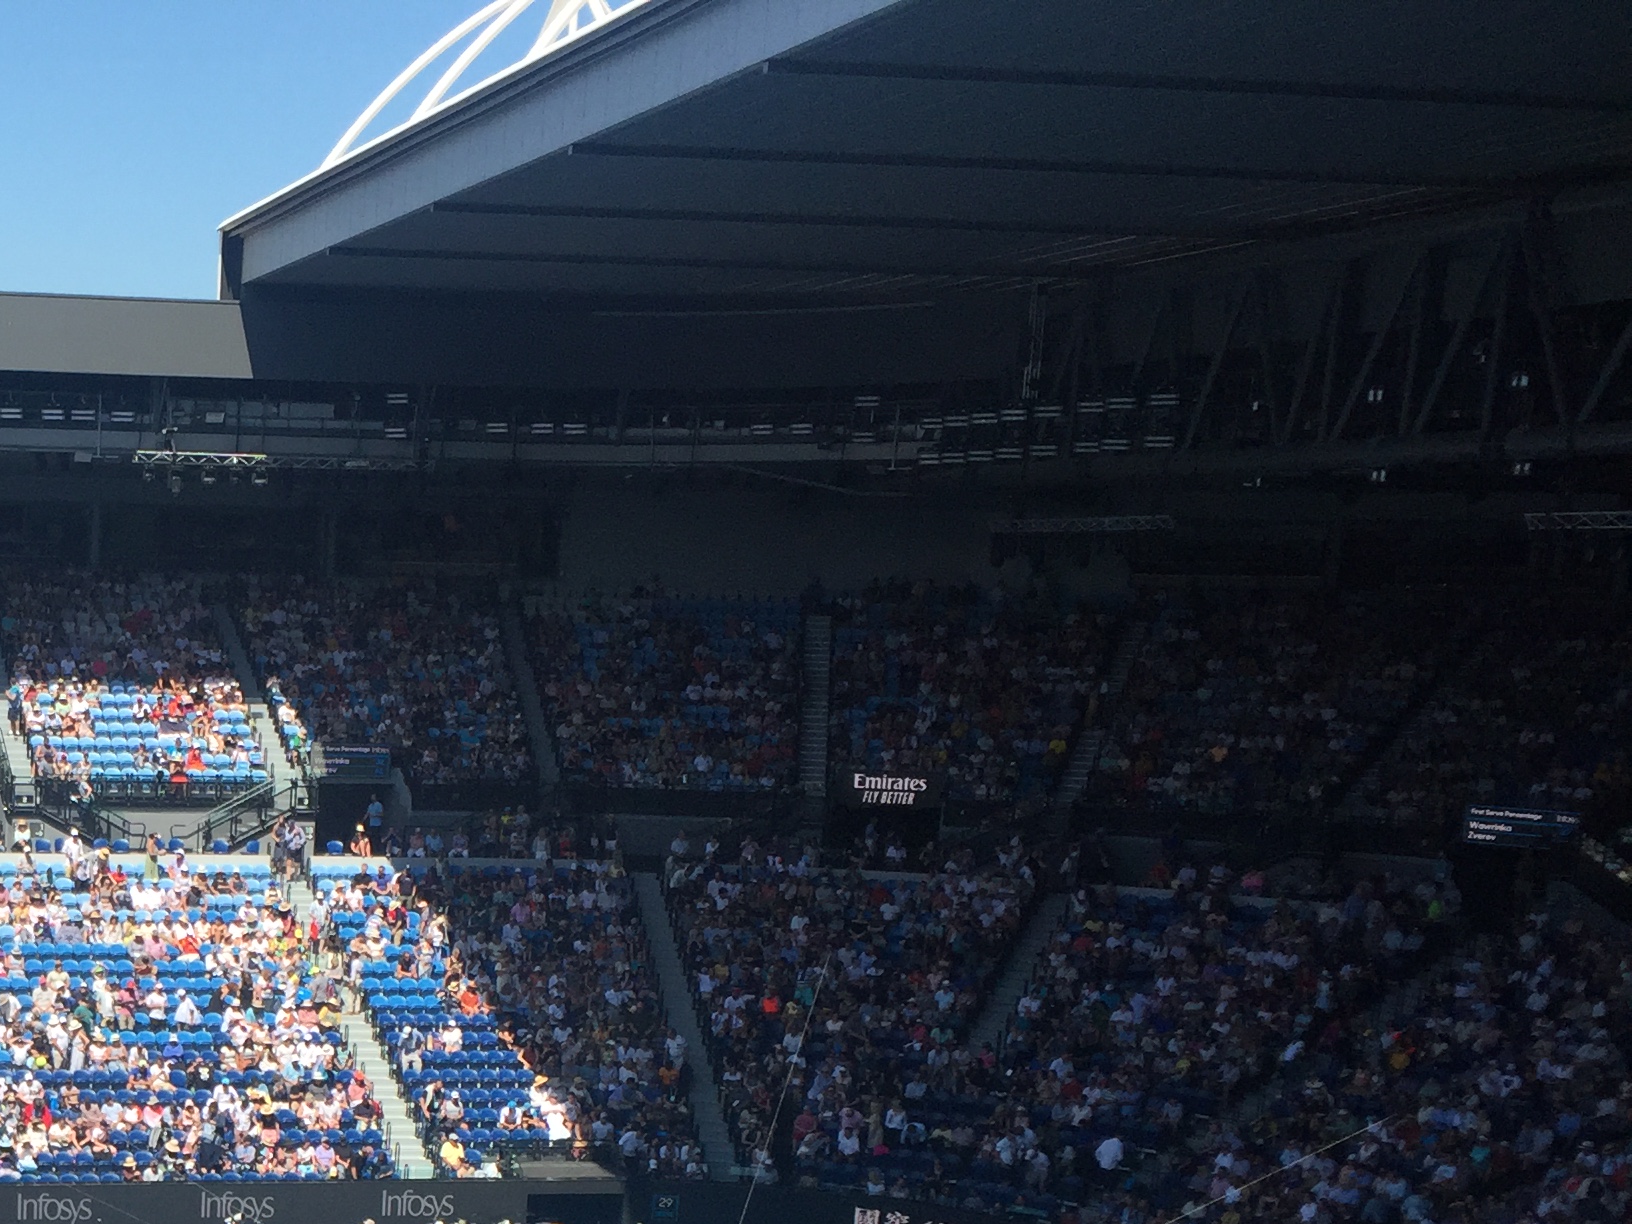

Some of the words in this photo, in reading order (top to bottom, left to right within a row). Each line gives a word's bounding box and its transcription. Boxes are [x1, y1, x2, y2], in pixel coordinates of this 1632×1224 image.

[854, 773, 927, 791] Emirates
[862, 791, 879, 803] FLY
[881, 792, 915, 805] BETTER
[17, 1193, 93, 1224] Infosys
[200, 1191, 275, 1223] Infosys
[381, 1190, 454, 1220] Infosys
[659, 1197, 673, 1207] 29
